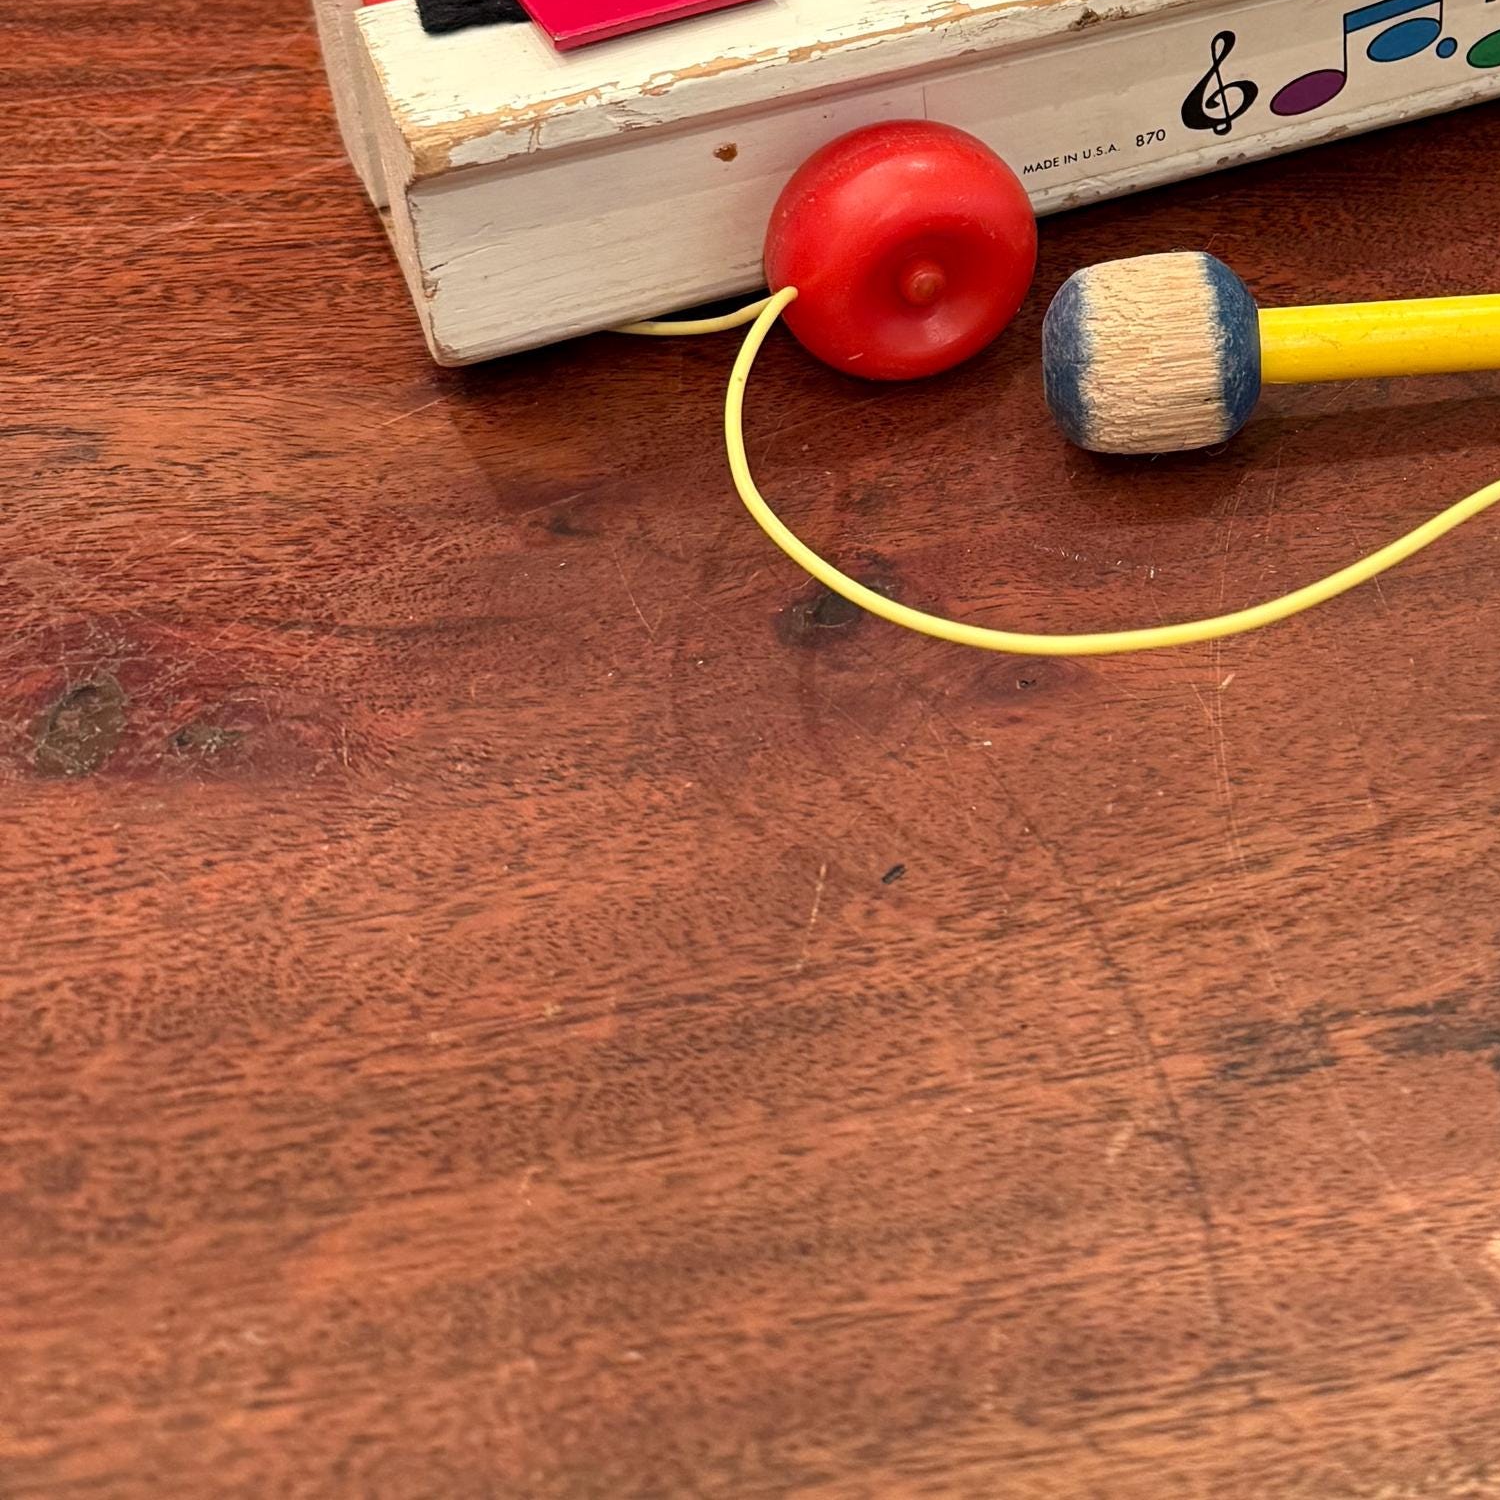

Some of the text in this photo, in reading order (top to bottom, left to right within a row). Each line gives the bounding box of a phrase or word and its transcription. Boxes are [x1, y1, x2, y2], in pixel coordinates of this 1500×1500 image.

[1023, 128, 1167, 175] MADE IN U.S.A. 870
